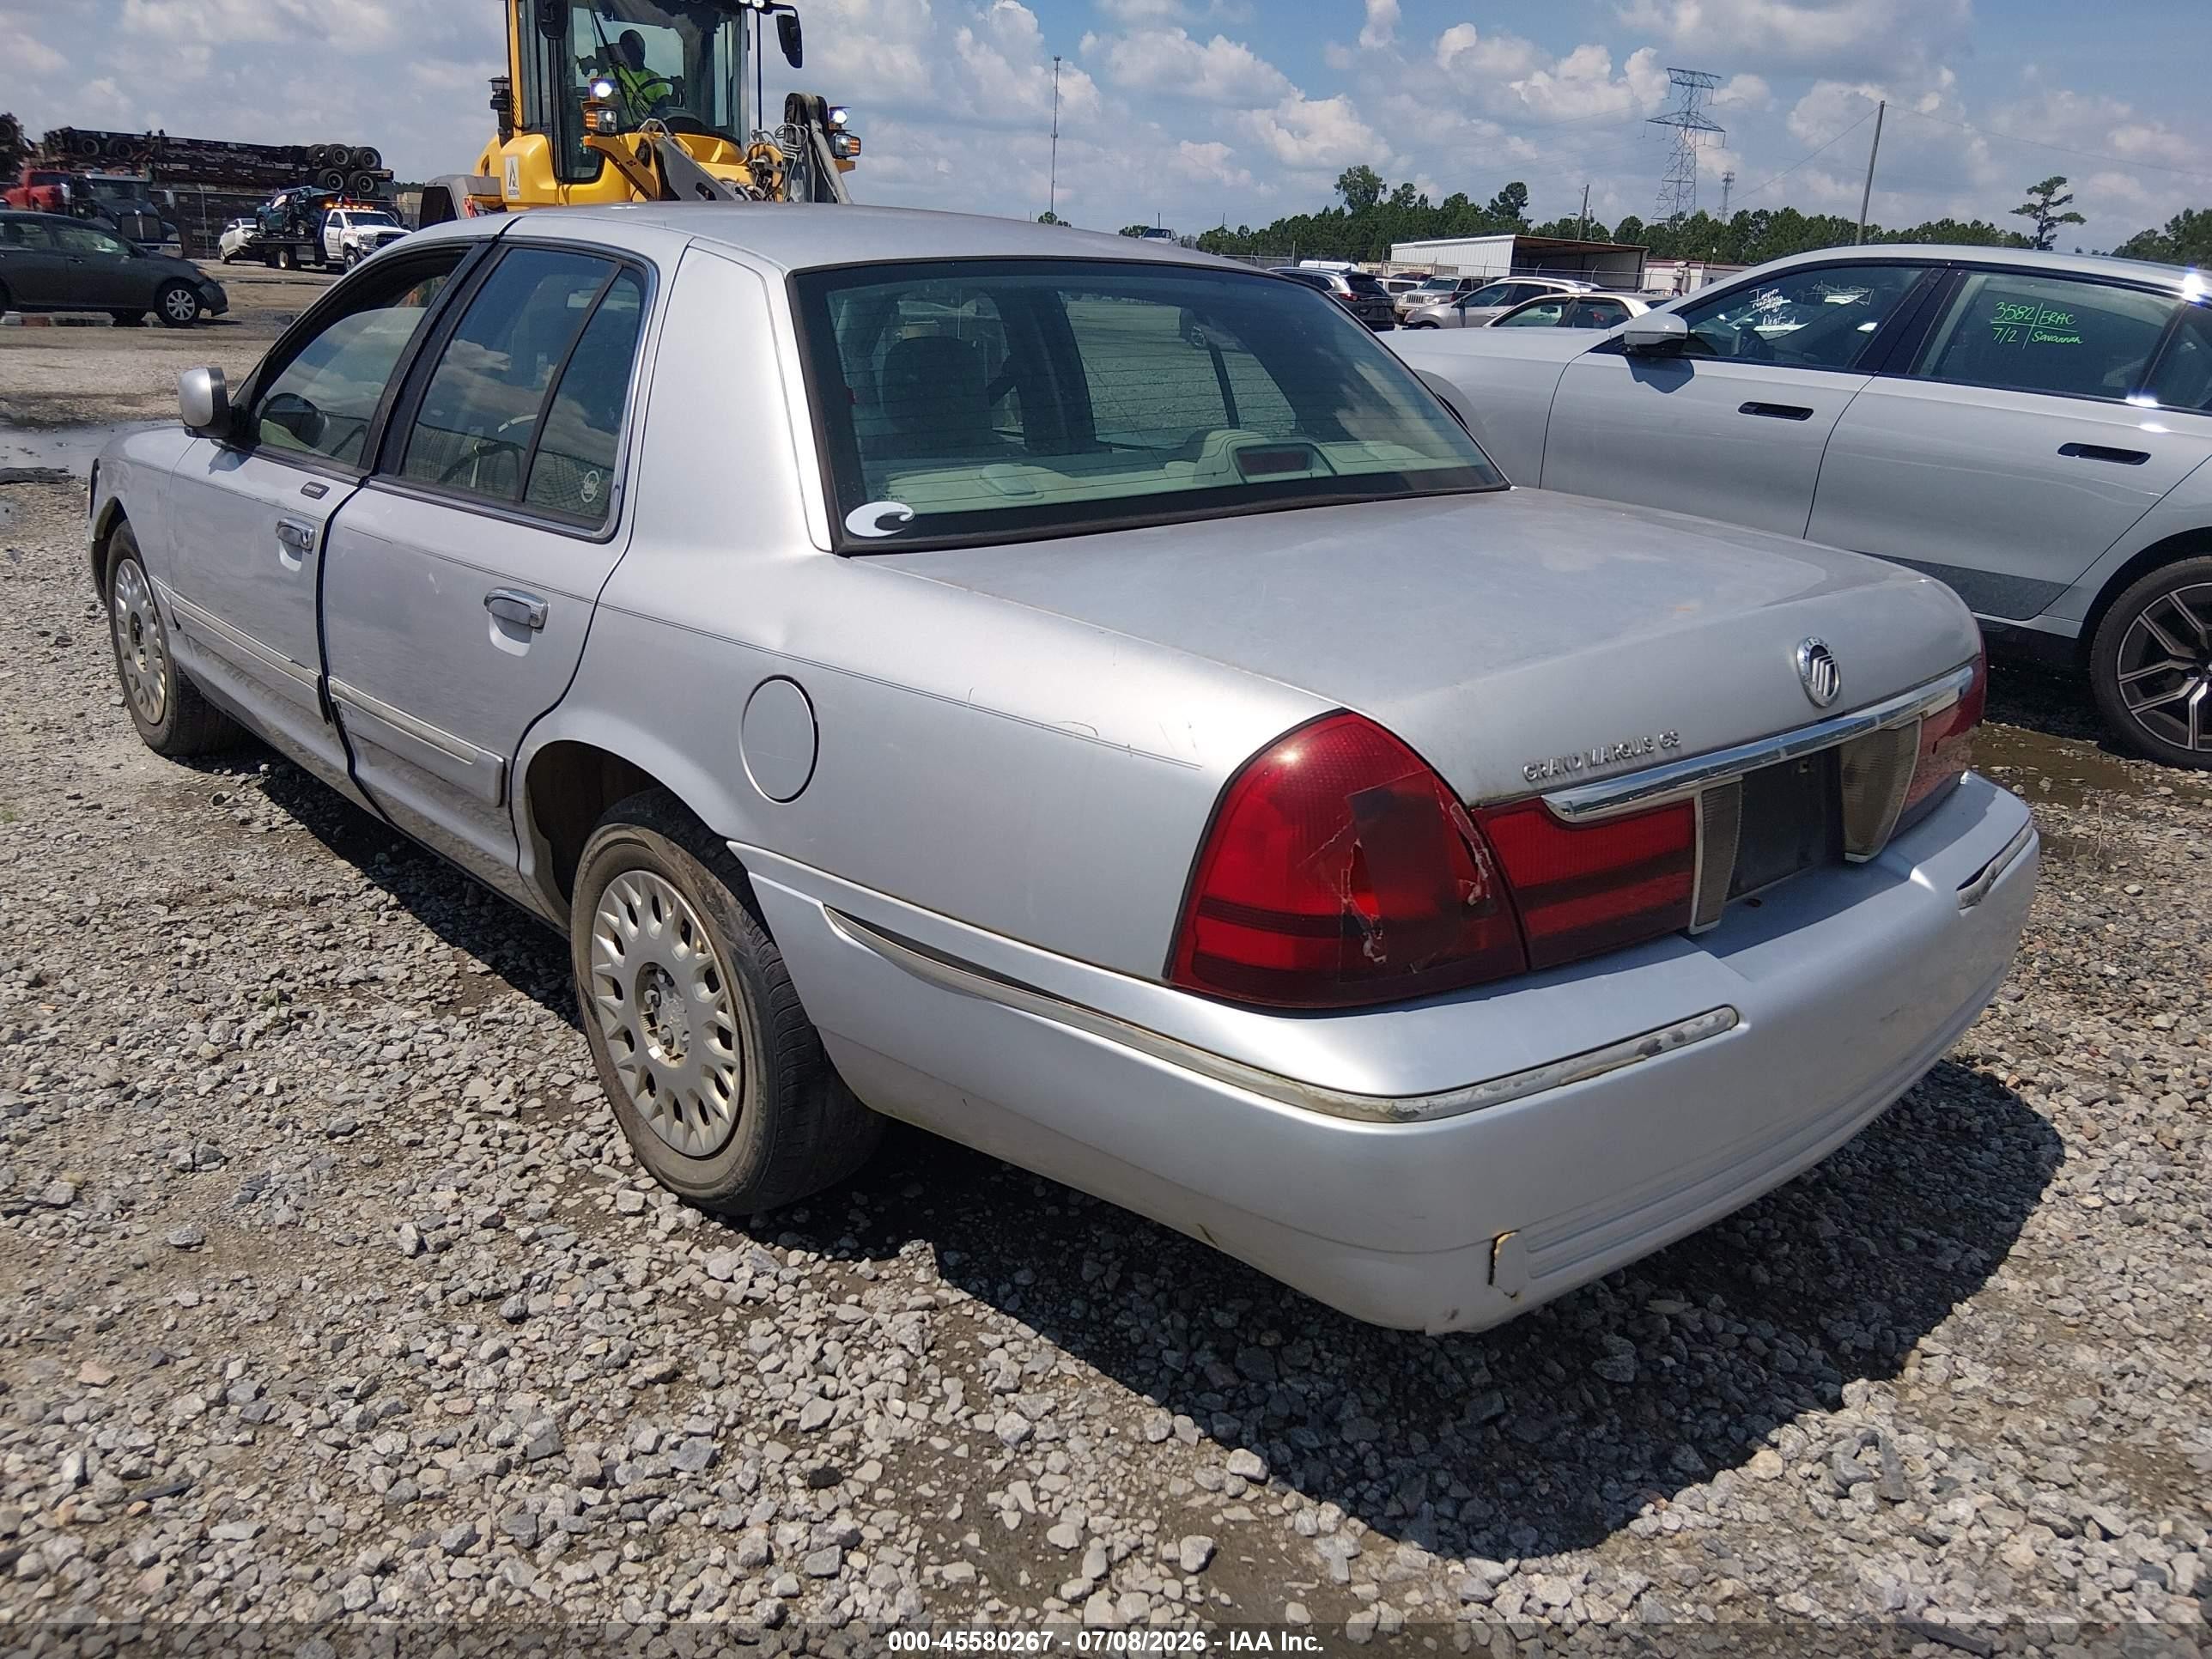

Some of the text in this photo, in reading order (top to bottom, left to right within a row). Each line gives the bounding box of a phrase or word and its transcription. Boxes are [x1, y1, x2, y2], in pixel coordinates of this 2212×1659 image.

[1994, 301, 2077, 325] 3582 ERAC
[1992, 326, 2084, 344] 7/2 Savannah
[1522, 730, 1681, 781] GRAND MARQUIS GS
